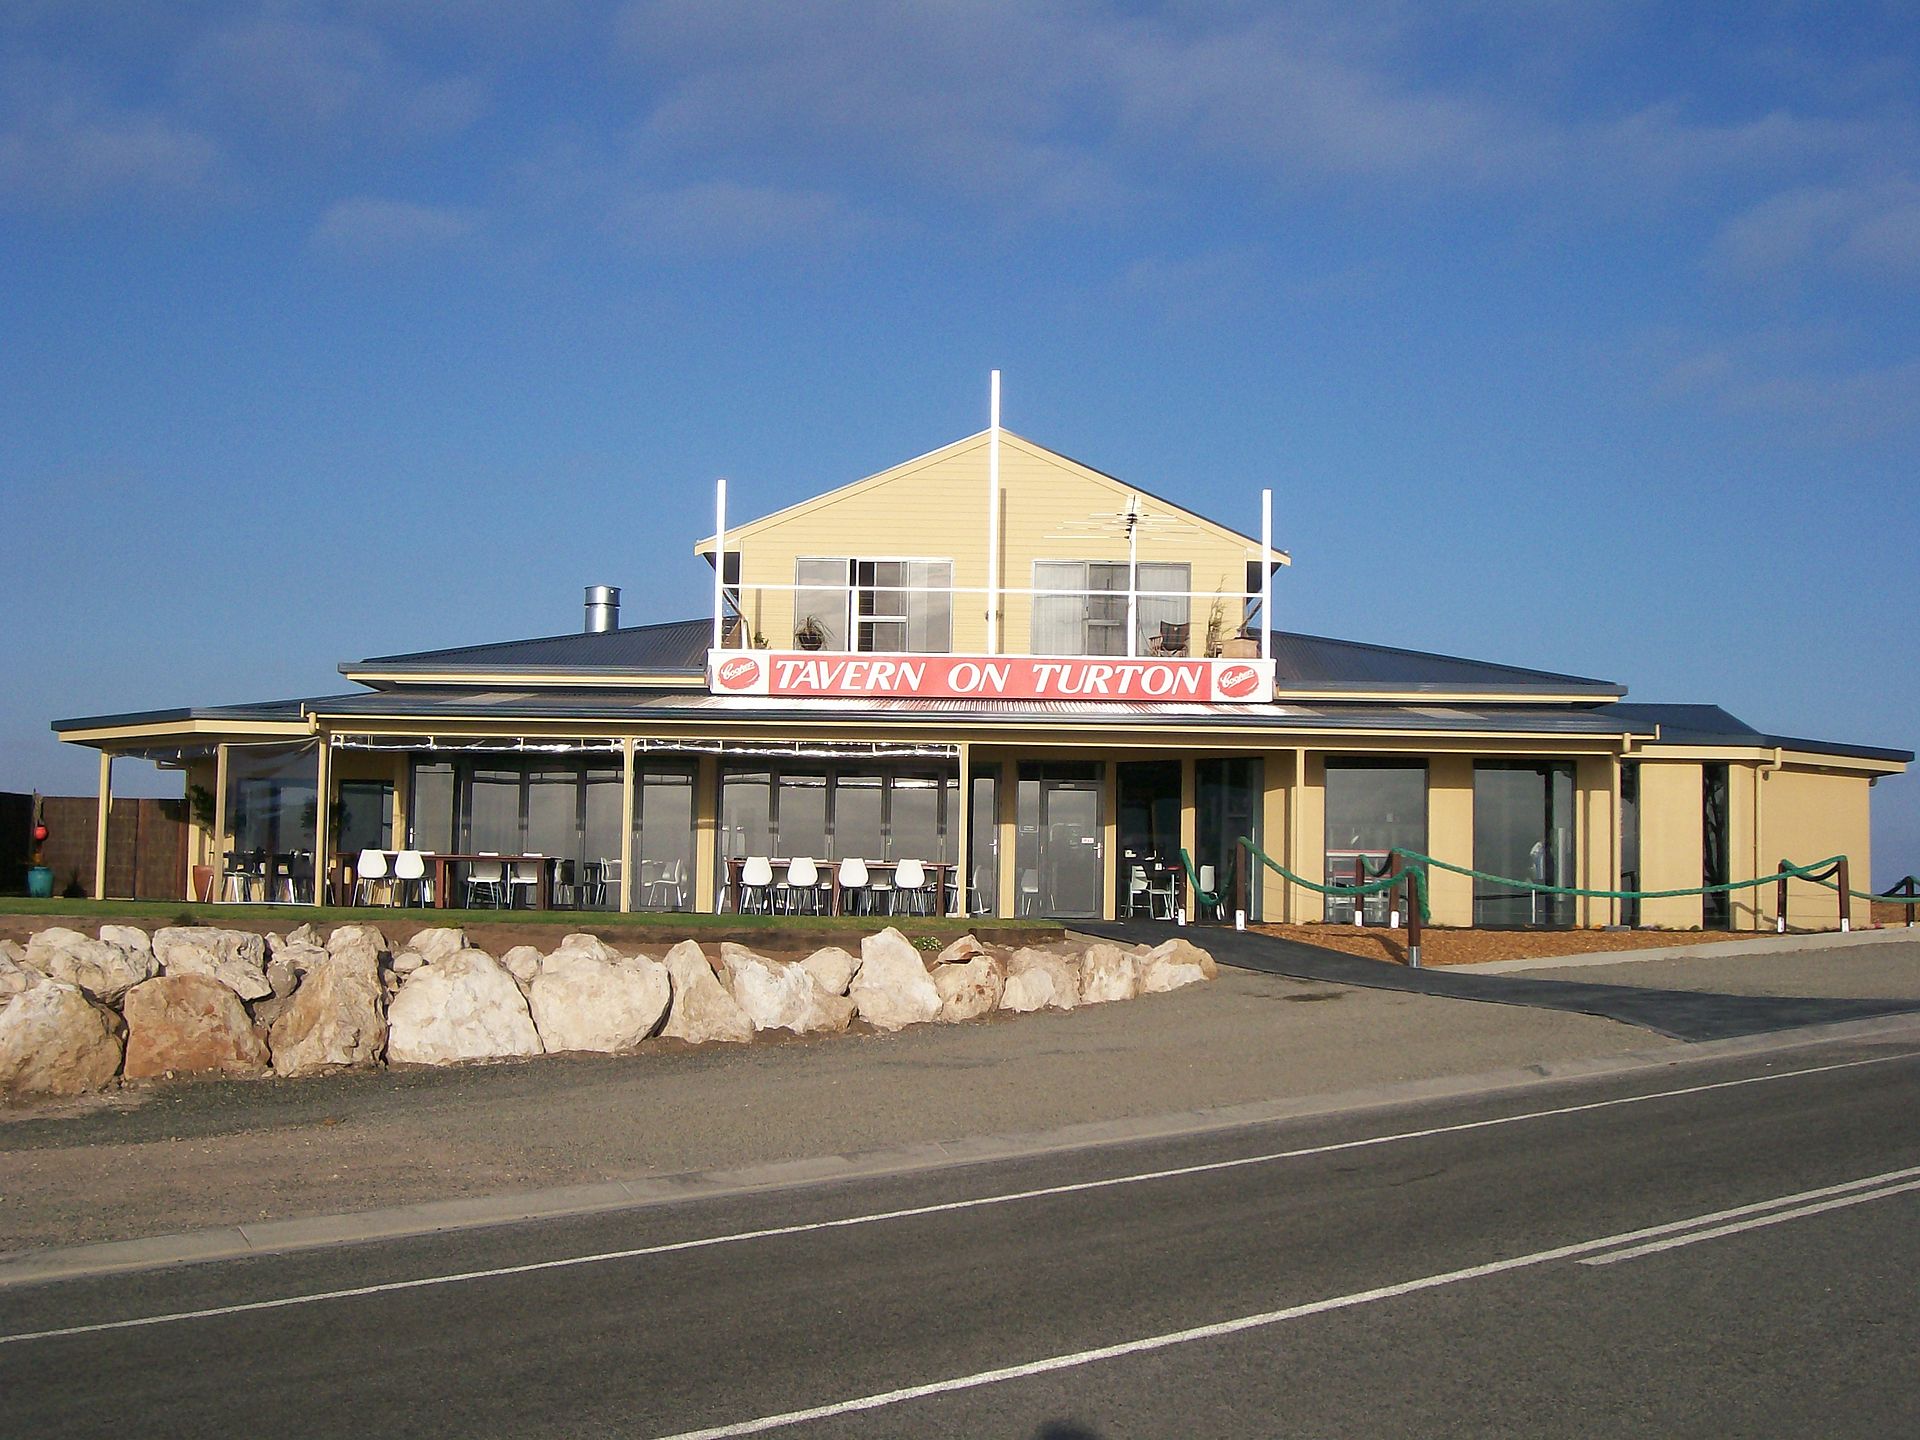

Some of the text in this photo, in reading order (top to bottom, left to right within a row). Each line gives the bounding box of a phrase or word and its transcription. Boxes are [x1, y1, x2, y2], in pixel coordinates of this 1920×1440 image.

[774, 660, 1202, 695] TAVERN ON TURTON
